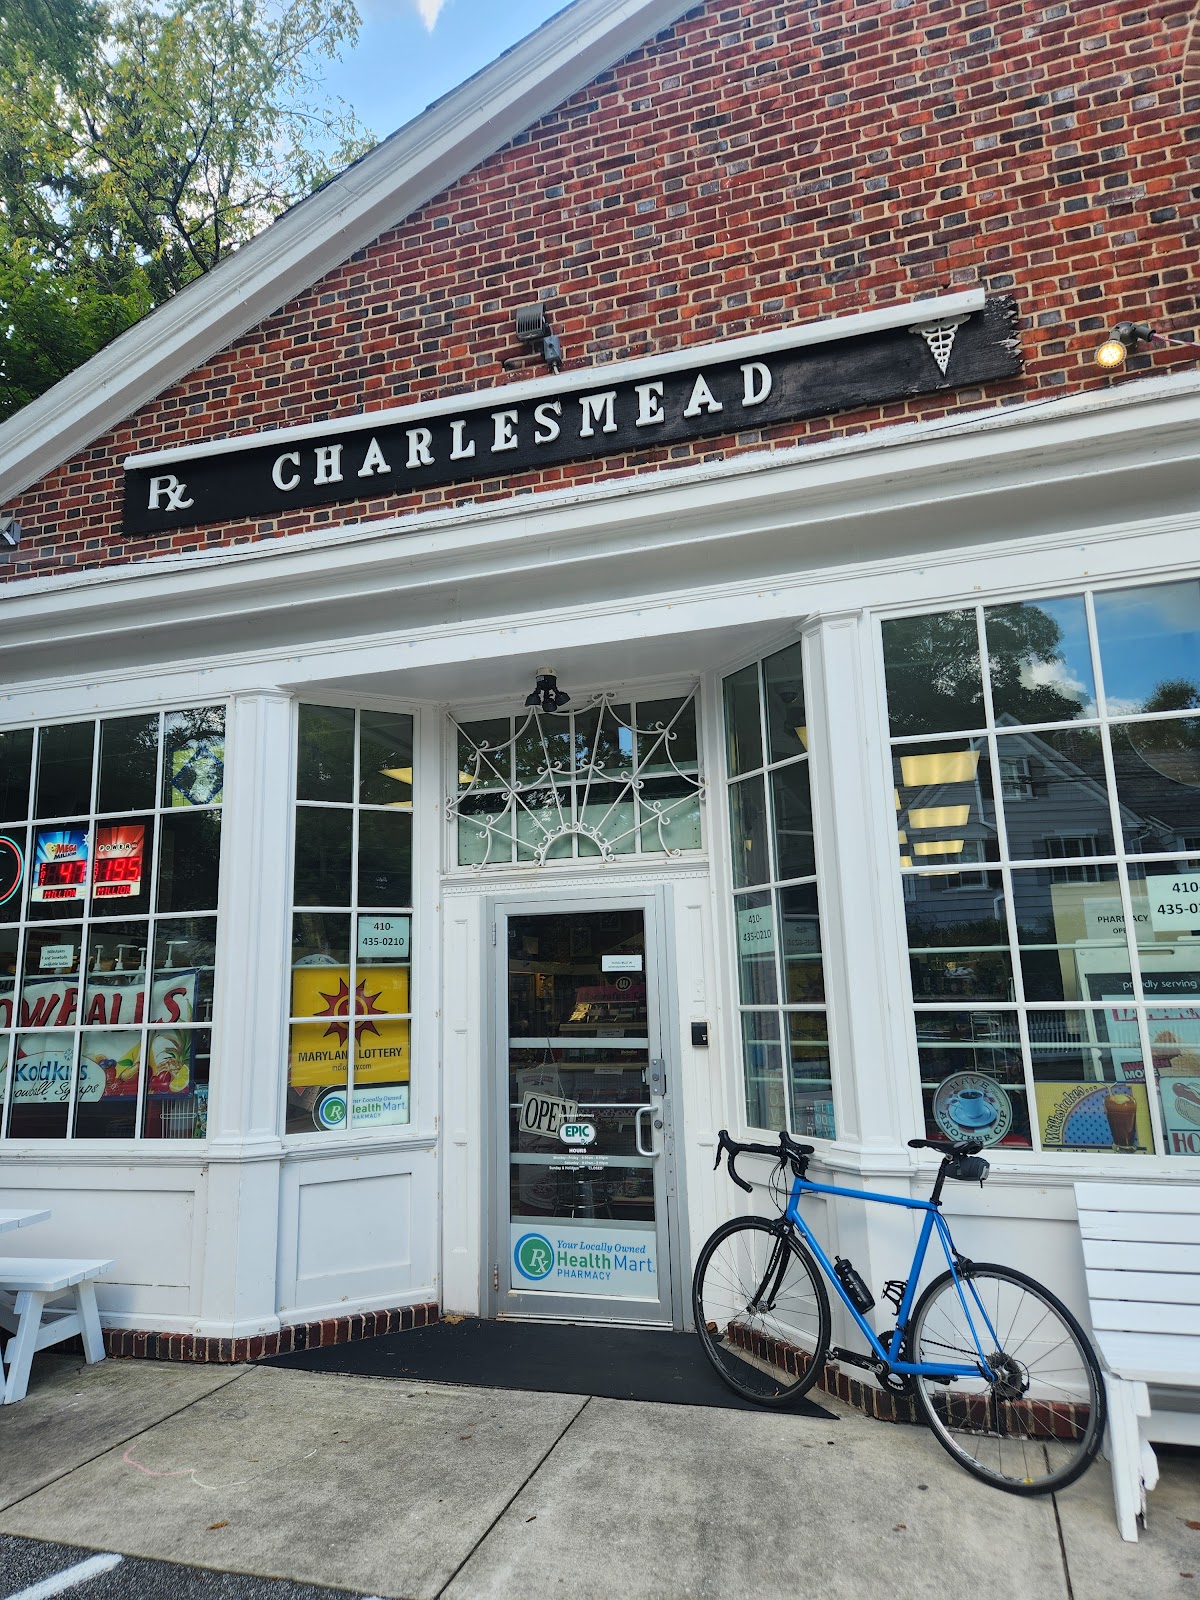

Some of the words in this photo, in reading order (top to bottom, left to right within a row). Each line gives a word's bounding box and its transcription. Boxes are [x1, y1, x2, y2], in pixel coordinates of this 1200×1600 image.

[271, 362, 772, 492] CHARLESMEAD
[56, 844, 77, 853] MEGA
[60, 861, 86, 883] 47
[106, 857, 141, 881] 195
[44, 889, 76, 898] MILLION
[97, 886, 131, 895] MILLION
[748, 914, 762, 924] 410-
[1097, 914, 1149, 923] PHARACY
[373, 922, 394, 930] 410-
[362, 937, 405, 946] 435-0210
[743, 929, 772, 942] 435-0210
[1122, 980, 1158, 990] prdly
[1162, 980, 1198, 989] serving
[298, 1050, 348, 1062] MARYLAN
[358, 1048, 402, 1059] LOTTERY
[15, 1060, 88, 1082] Koldkis
[332, 1062, 372, 1071] mdlory.com
[949, 1078, 990, 1090] HAVE
[54, 1082, 100, 1100] Syups
[525, 1097, 573, 1134] OPEN
[565, 1125, 590, 1138] EPIC
[939, 1110, 993, 1142] ANOTHER
[993, 1110, 1007, 1135] CUP
[557, 1240, 578, 1250] Your
[580, 1241, 613, 1252] Locally
[614, 1244, 646, 1254] Owned
[557, 1251, 611, 1270] Health
[557, 1268, 612, 1280] PHARMACY
